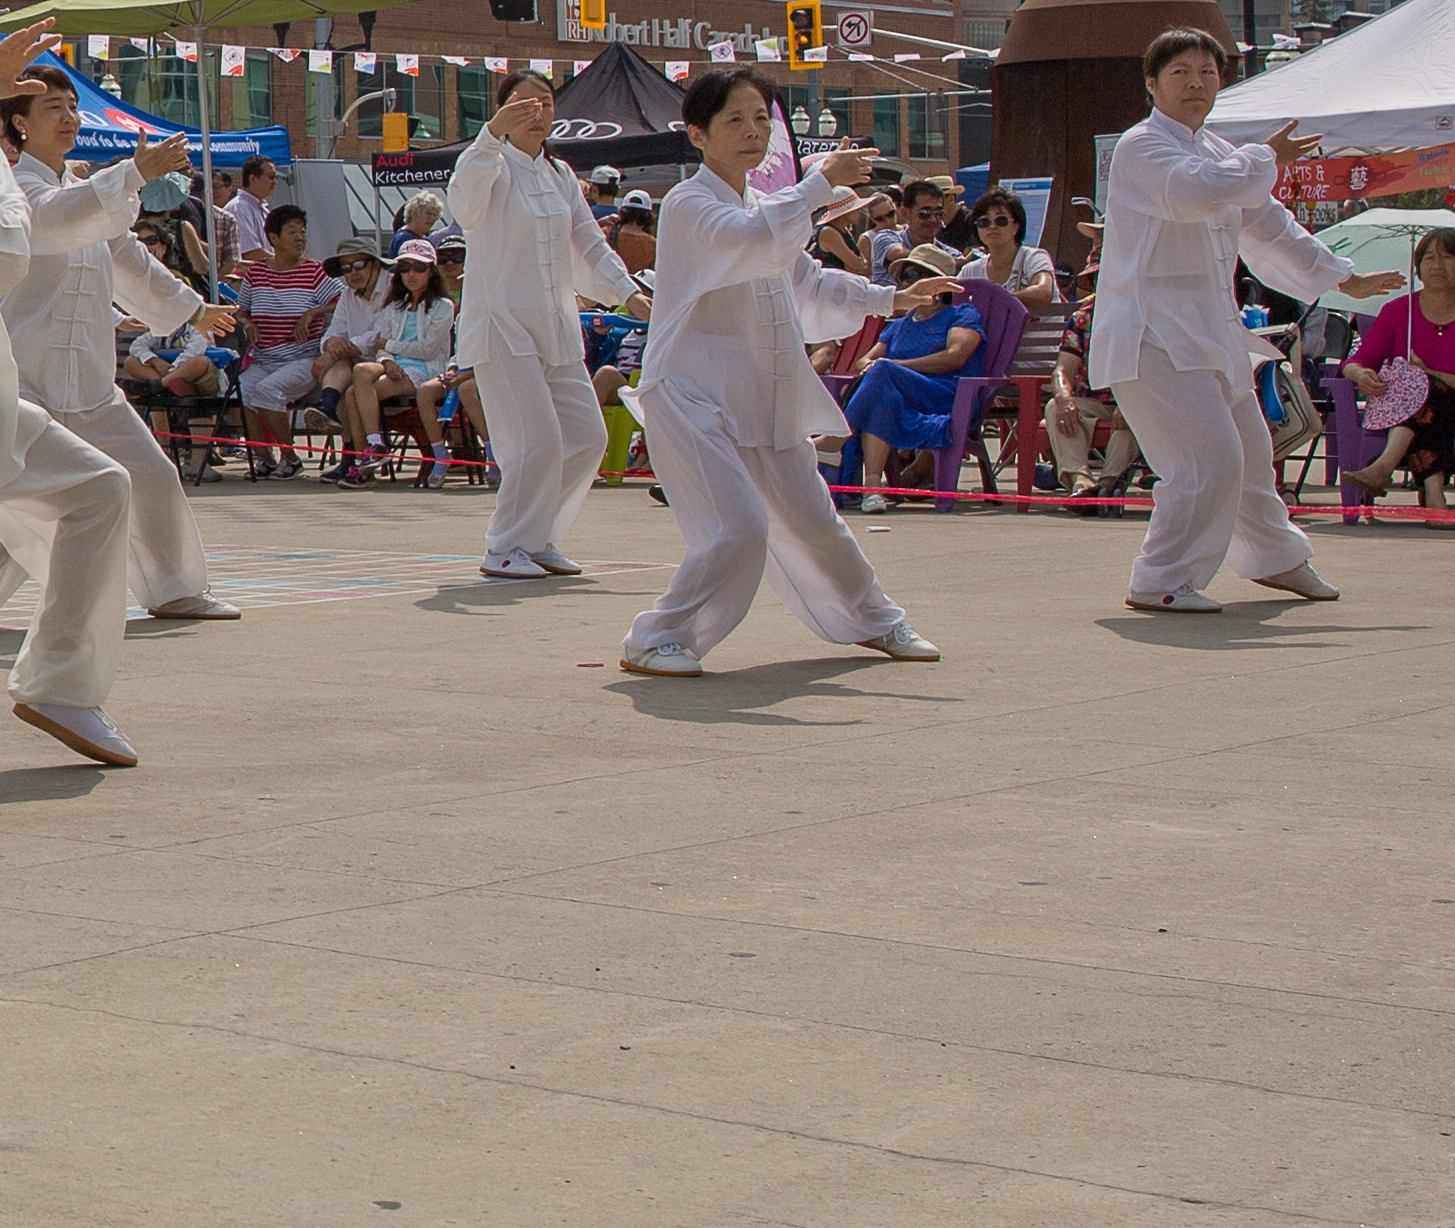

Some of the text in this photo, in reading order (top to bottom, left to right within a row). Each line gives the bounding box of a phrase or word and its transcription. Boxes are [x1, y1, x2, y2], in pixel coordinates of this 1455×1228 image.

[651, 18, 692, 48] Half
[376, 153, 414, 168] Audi
[375, 168, 451, 185] Kitchener
[1316, 164, 1325, 182] &
